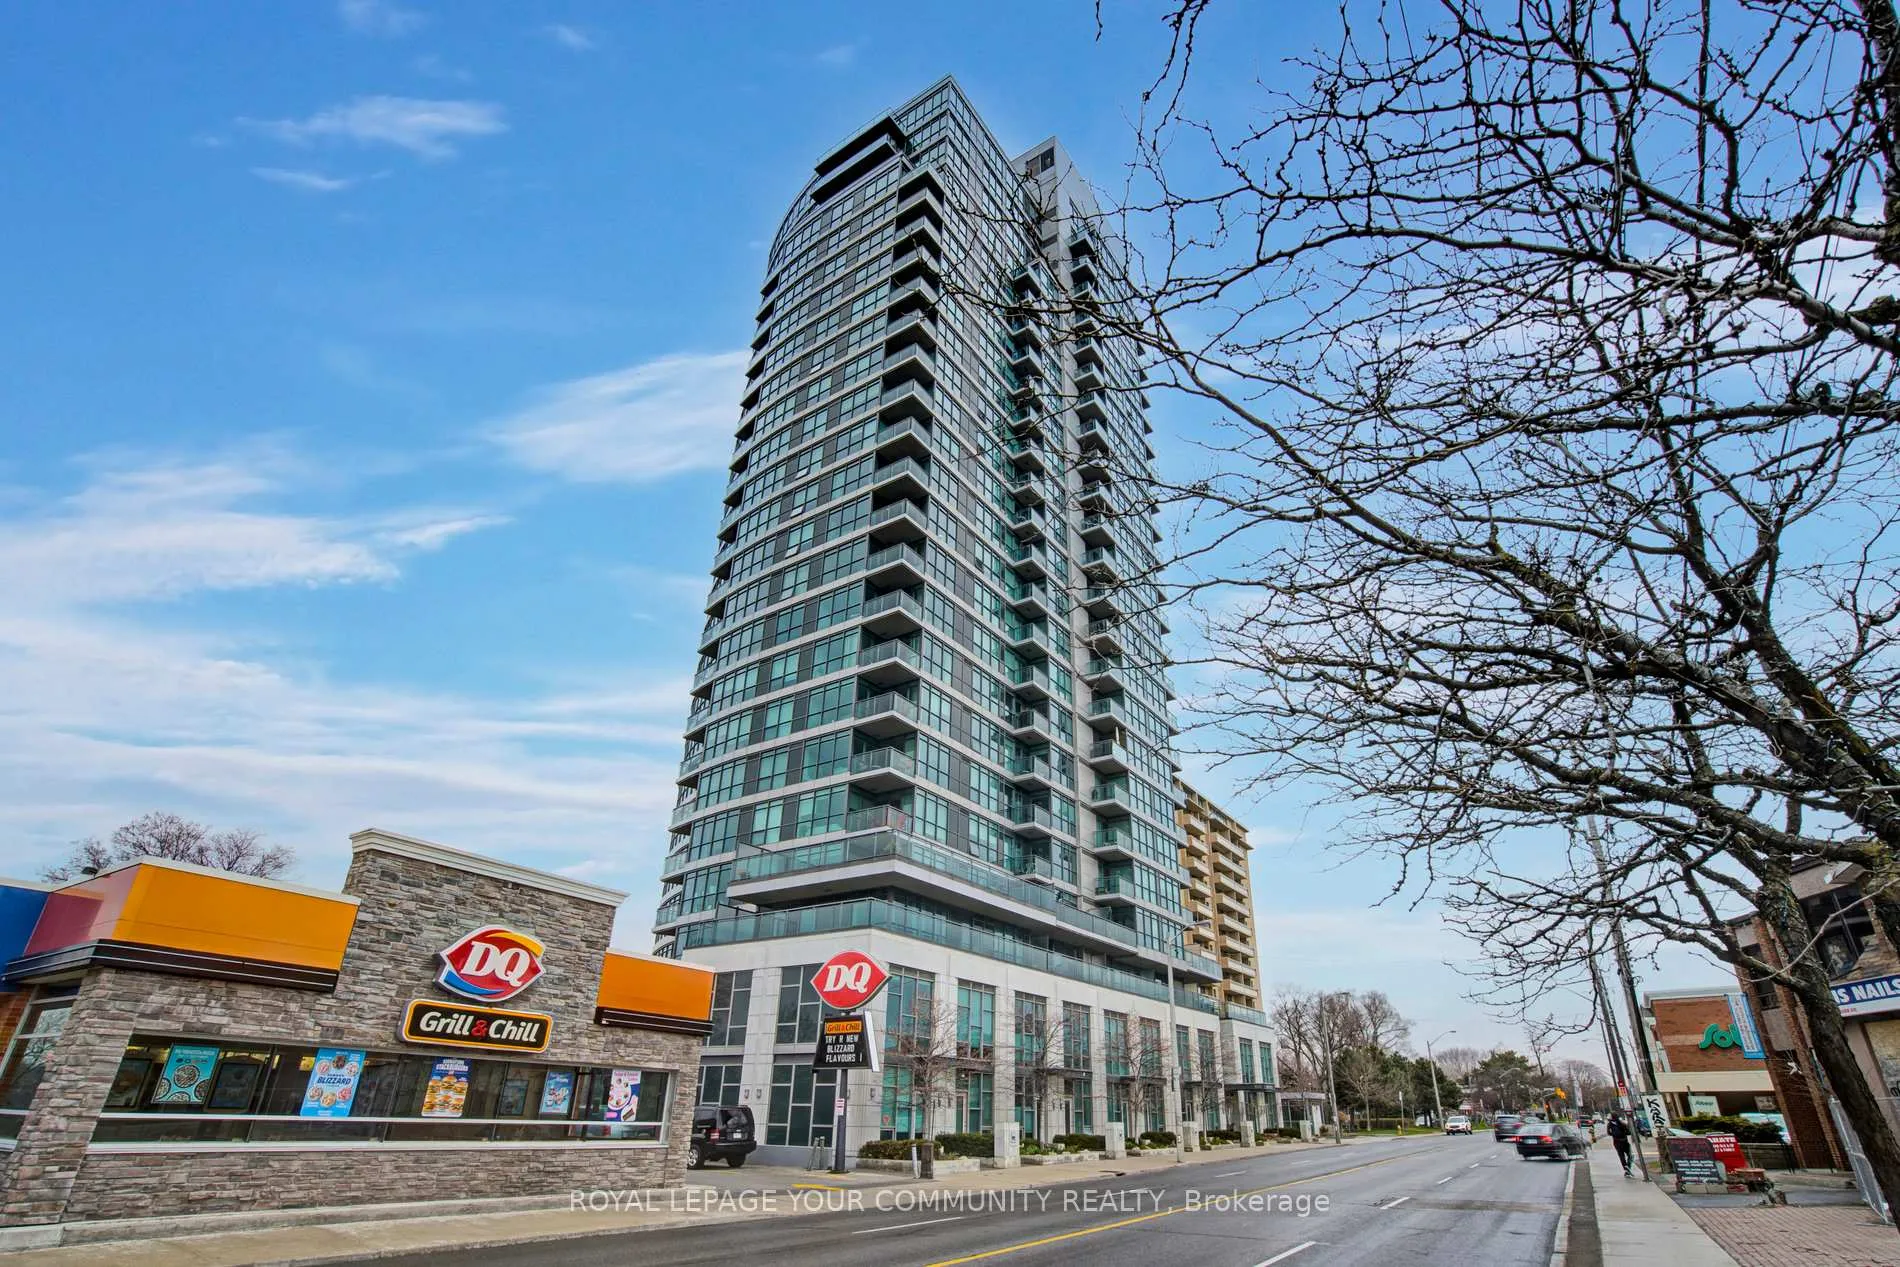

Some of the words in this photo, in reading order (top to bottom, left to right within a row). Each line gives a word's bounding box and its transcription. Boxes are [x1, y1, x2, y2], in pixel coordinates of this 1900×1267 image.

[460, 941, 531, 987] DQ
[823, 962, 872, 993] DQ
[1851, 979, 1900, 1001] NAILS
[419, 1011, 474, 1035] Grill
[488, 1019, 540, 1042] Chill
[825, 1034, 837, 1044] TRY
[845, 1033, 859, 1043] NEW
[826, 1044, 855, 1053] BLIZZARD
[825, 1053, 856, 1063] FLAVOURS
[317, 1076, 352, 1085] BLIZZARD
